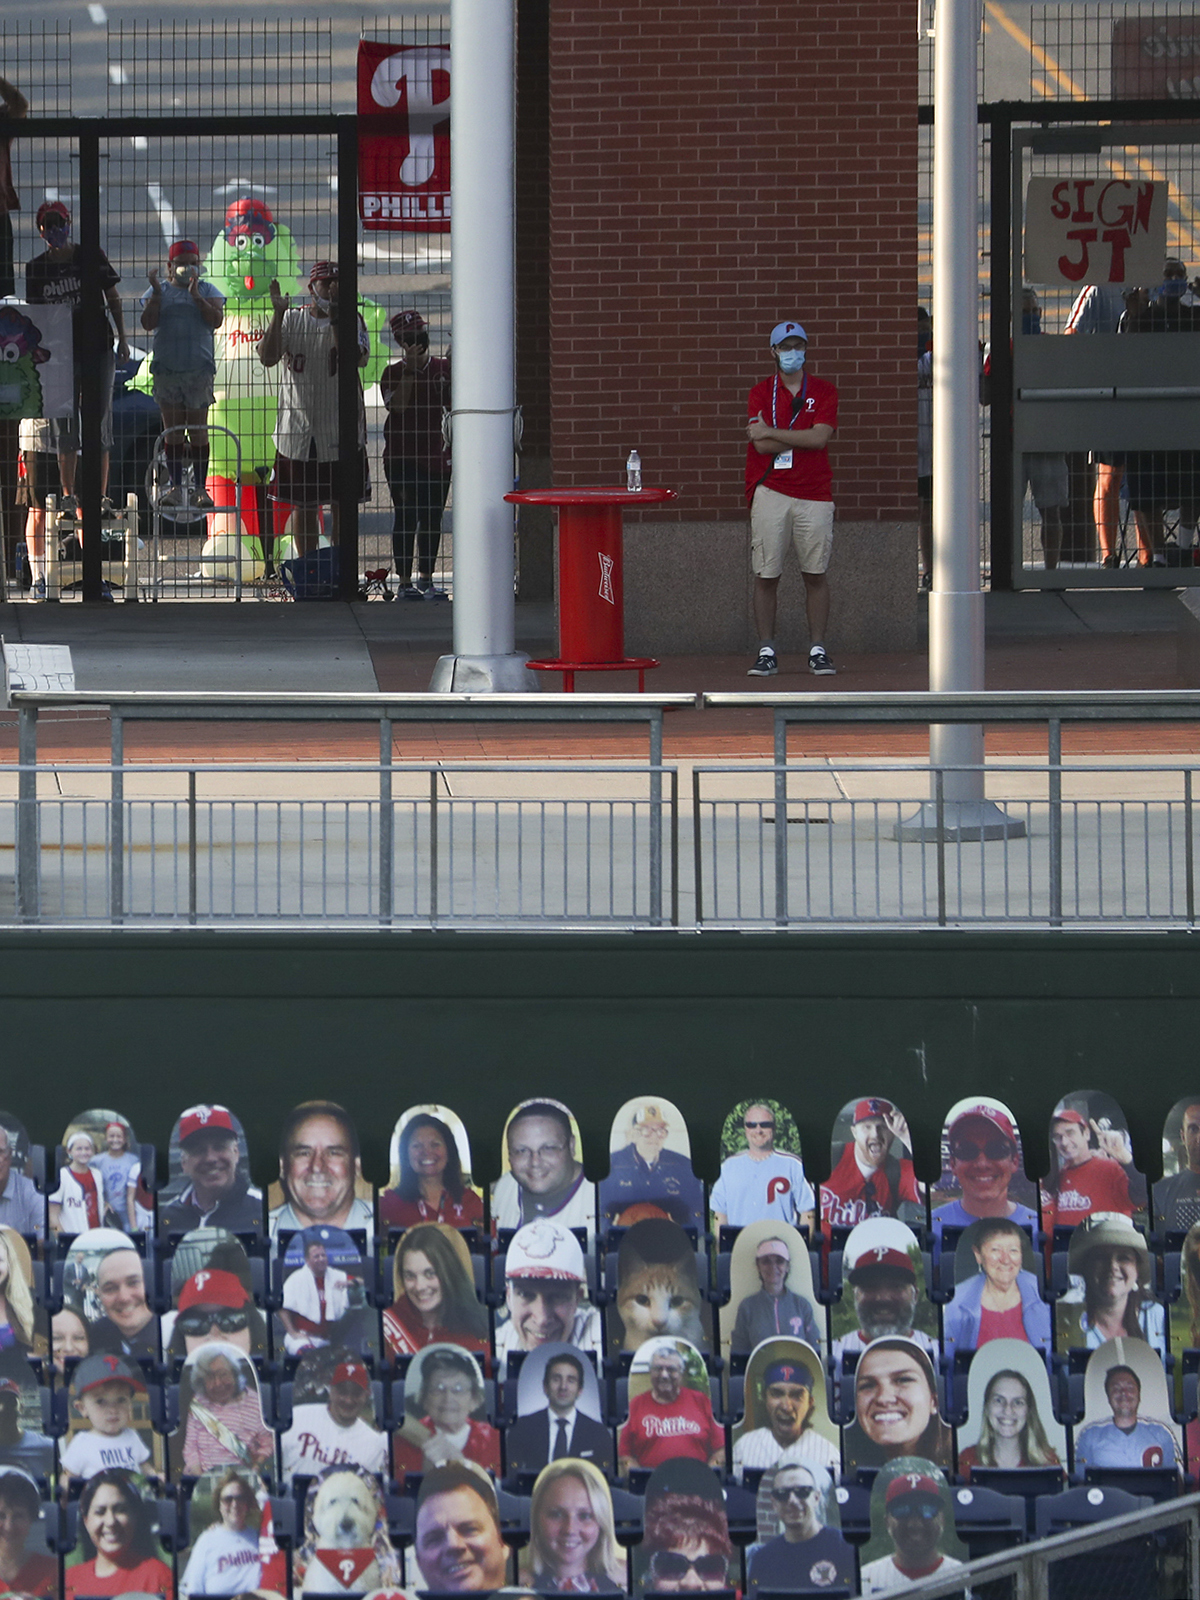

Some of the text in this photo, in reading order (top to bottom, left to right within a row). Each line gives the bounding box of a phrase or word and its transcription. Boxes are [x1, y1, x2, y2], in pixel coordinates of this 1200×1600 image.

[363, 196, 451, 218] PHILLI
[1050, 179, 1154, 235] SIGN
[1058, 228, 1132, 282] JT
[767, 1176, 791, 1205] P
[641, 1415, 701, 1438] Phillies
[100, 1446, 135, 1465] MILK
[298, 1432, 352, 1466] Phill
